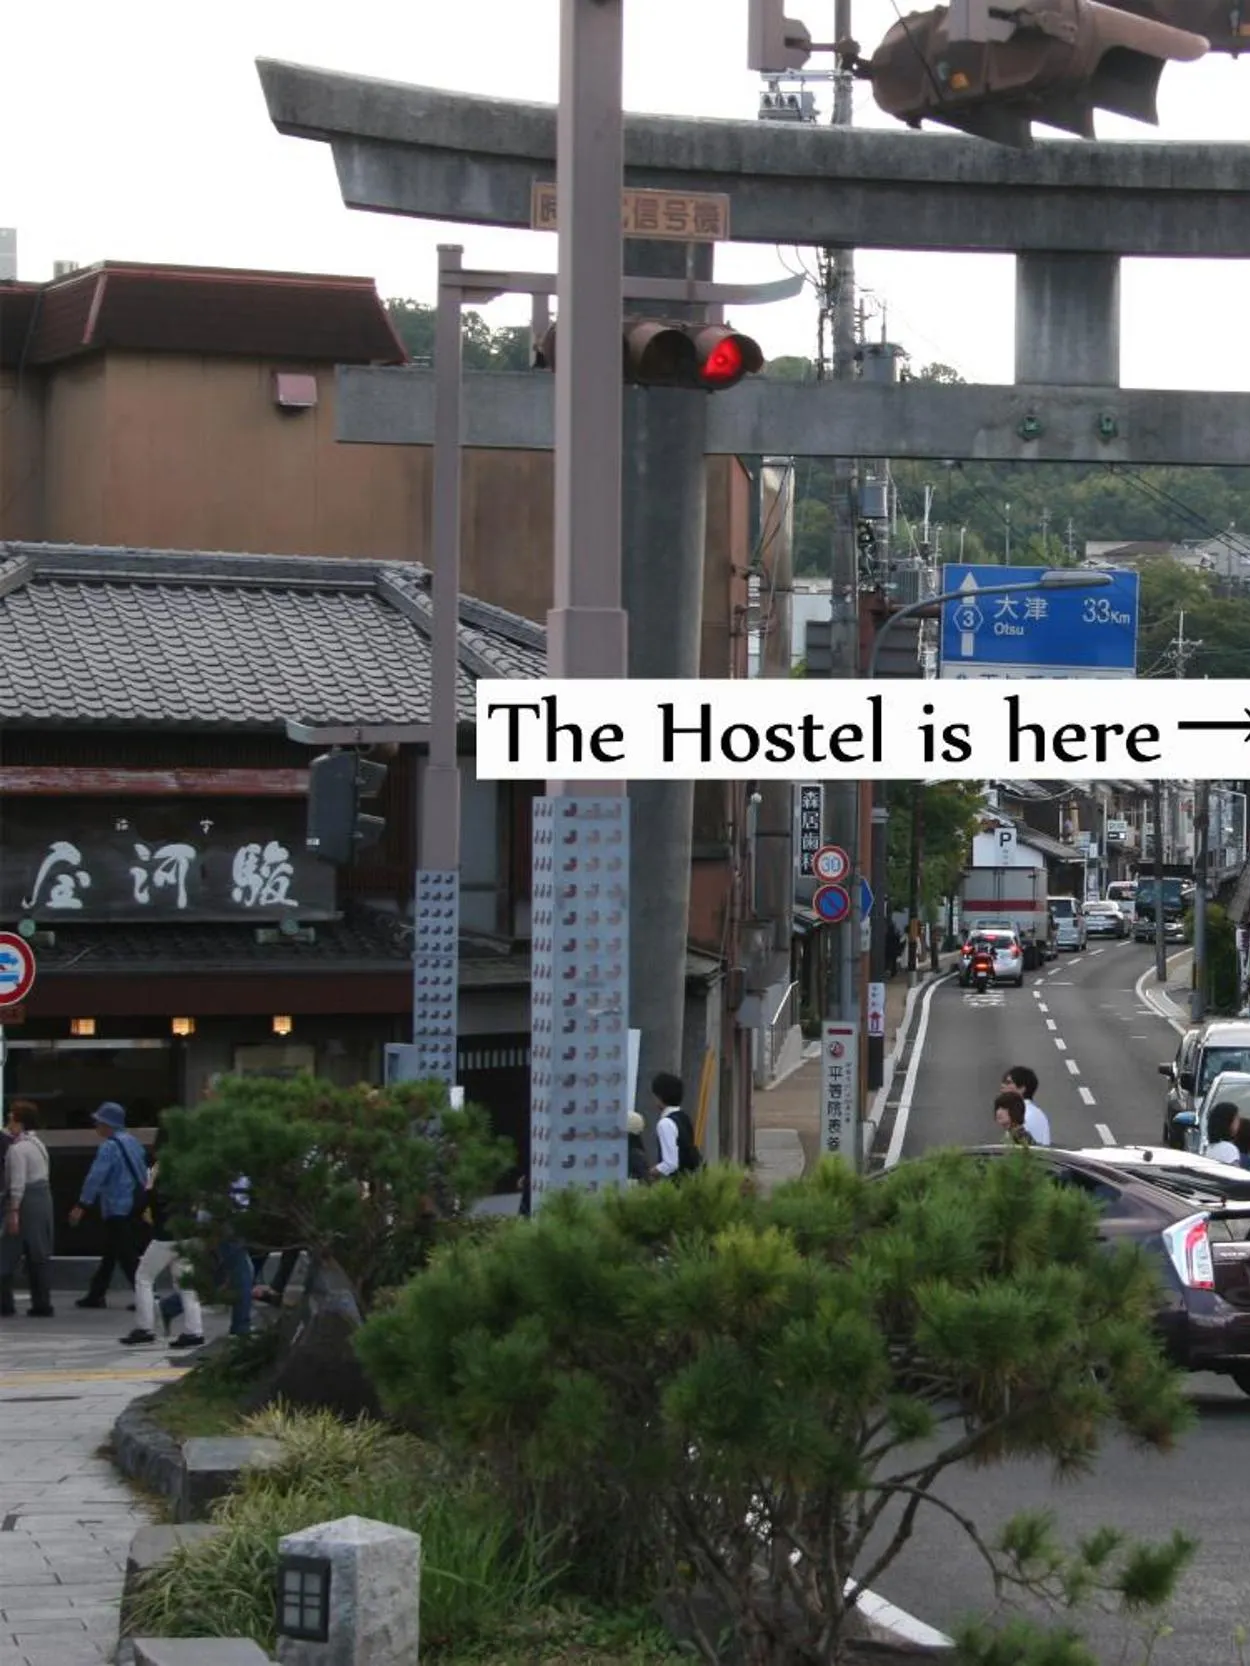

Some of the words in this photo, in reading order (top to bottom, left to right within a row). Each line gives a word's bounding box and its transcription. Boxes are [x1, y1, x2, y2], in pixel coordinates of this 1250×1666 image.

[540, 193, 722, 234] 時信号機
[994, 597, 1048, 620] 大津
[962, 610, 974, 628] 3
[994, 622, 1024, 636] Otsu
[1000, 832, 1012, 848] P
